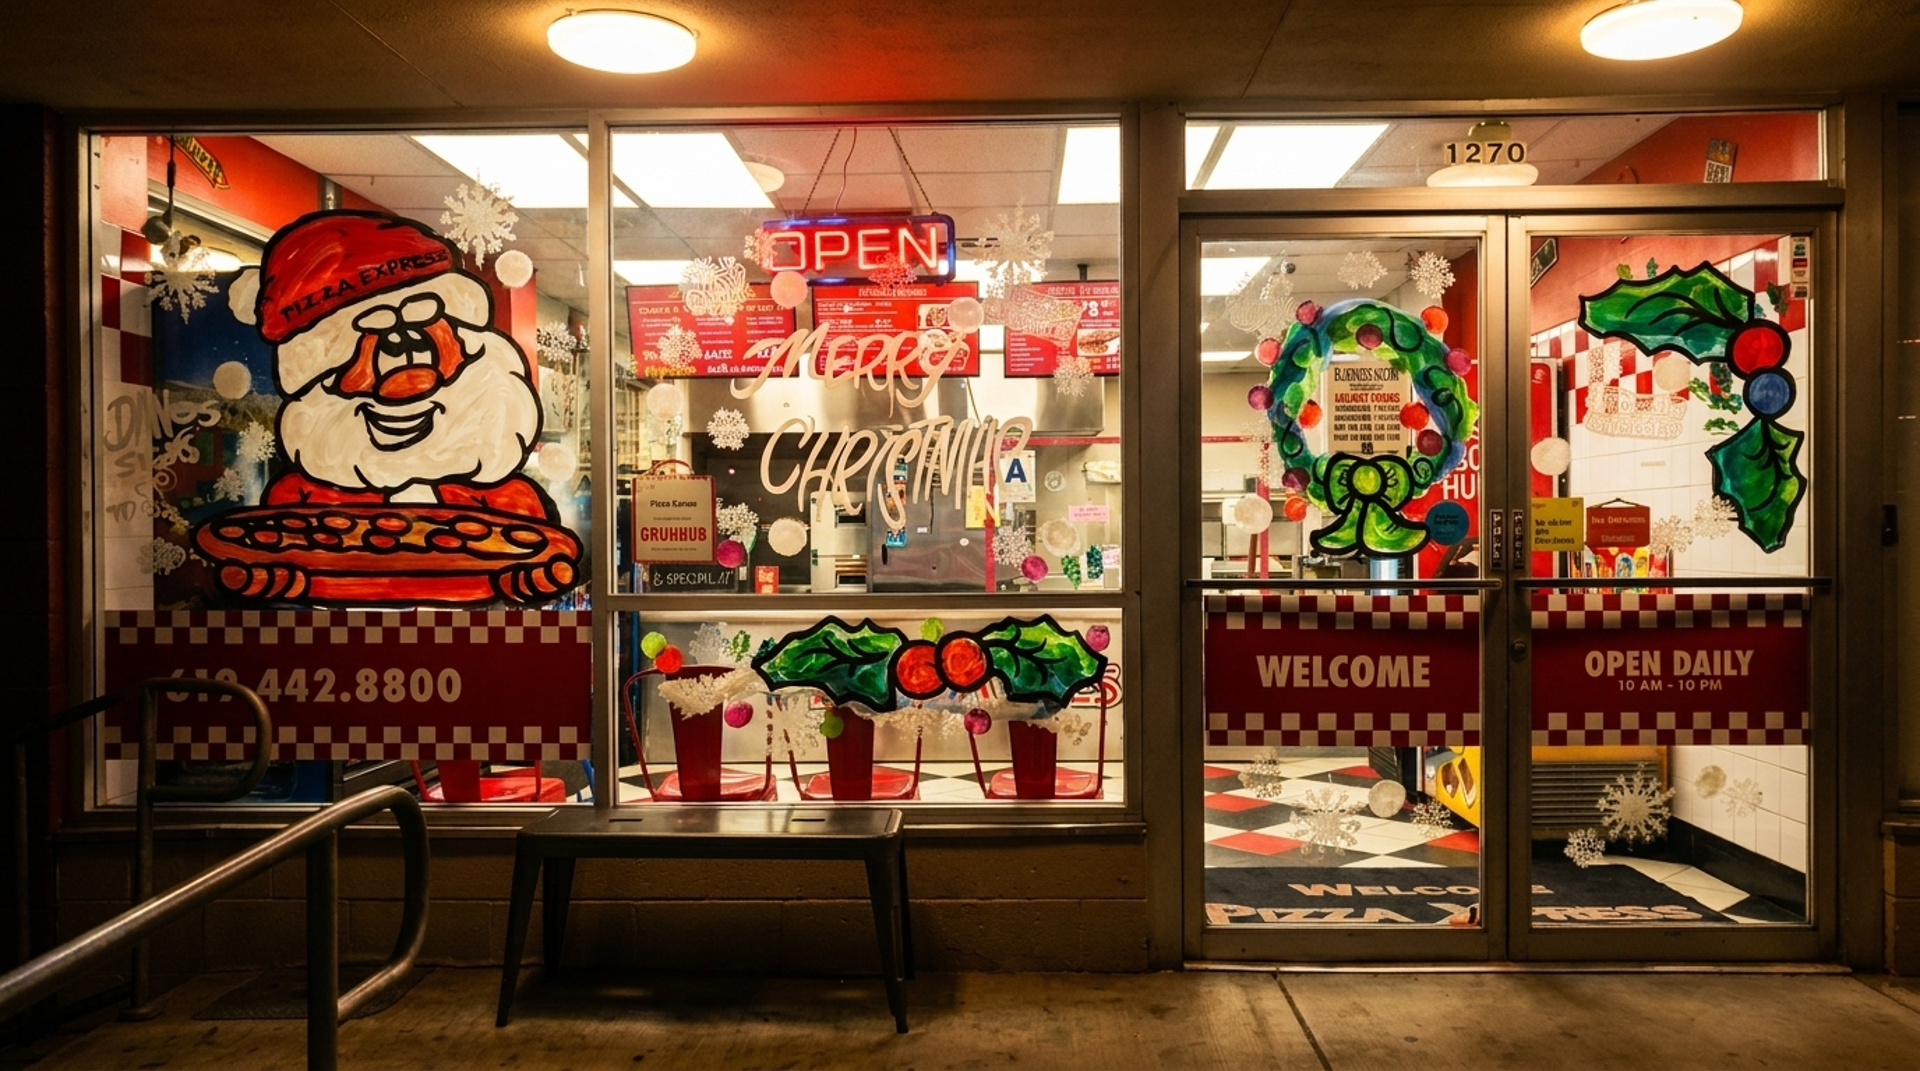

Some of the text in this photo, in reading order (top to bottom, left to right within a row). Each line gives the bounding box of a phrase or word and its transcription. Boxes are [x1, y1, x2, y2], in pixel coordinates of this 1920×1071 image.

[1446, 142, 1525, 163] 1270
[769, 226, 938, 272] OPEN
[730, 322, 967, 418] MERRY
[1005, 458, 1027, 483] A
[1256, 654, 1431, 688] WELCOME
[1584, 650, 1754, 677] OPEN DAILY
[1618, 679, 1635, 691] 10
[1639, 679, 1663, 691] AM
[1678, 679, 1695, 691] 10
[1700, 679, 1722, 691] PM
[1205, 903, 1416, 924] PIZZA
